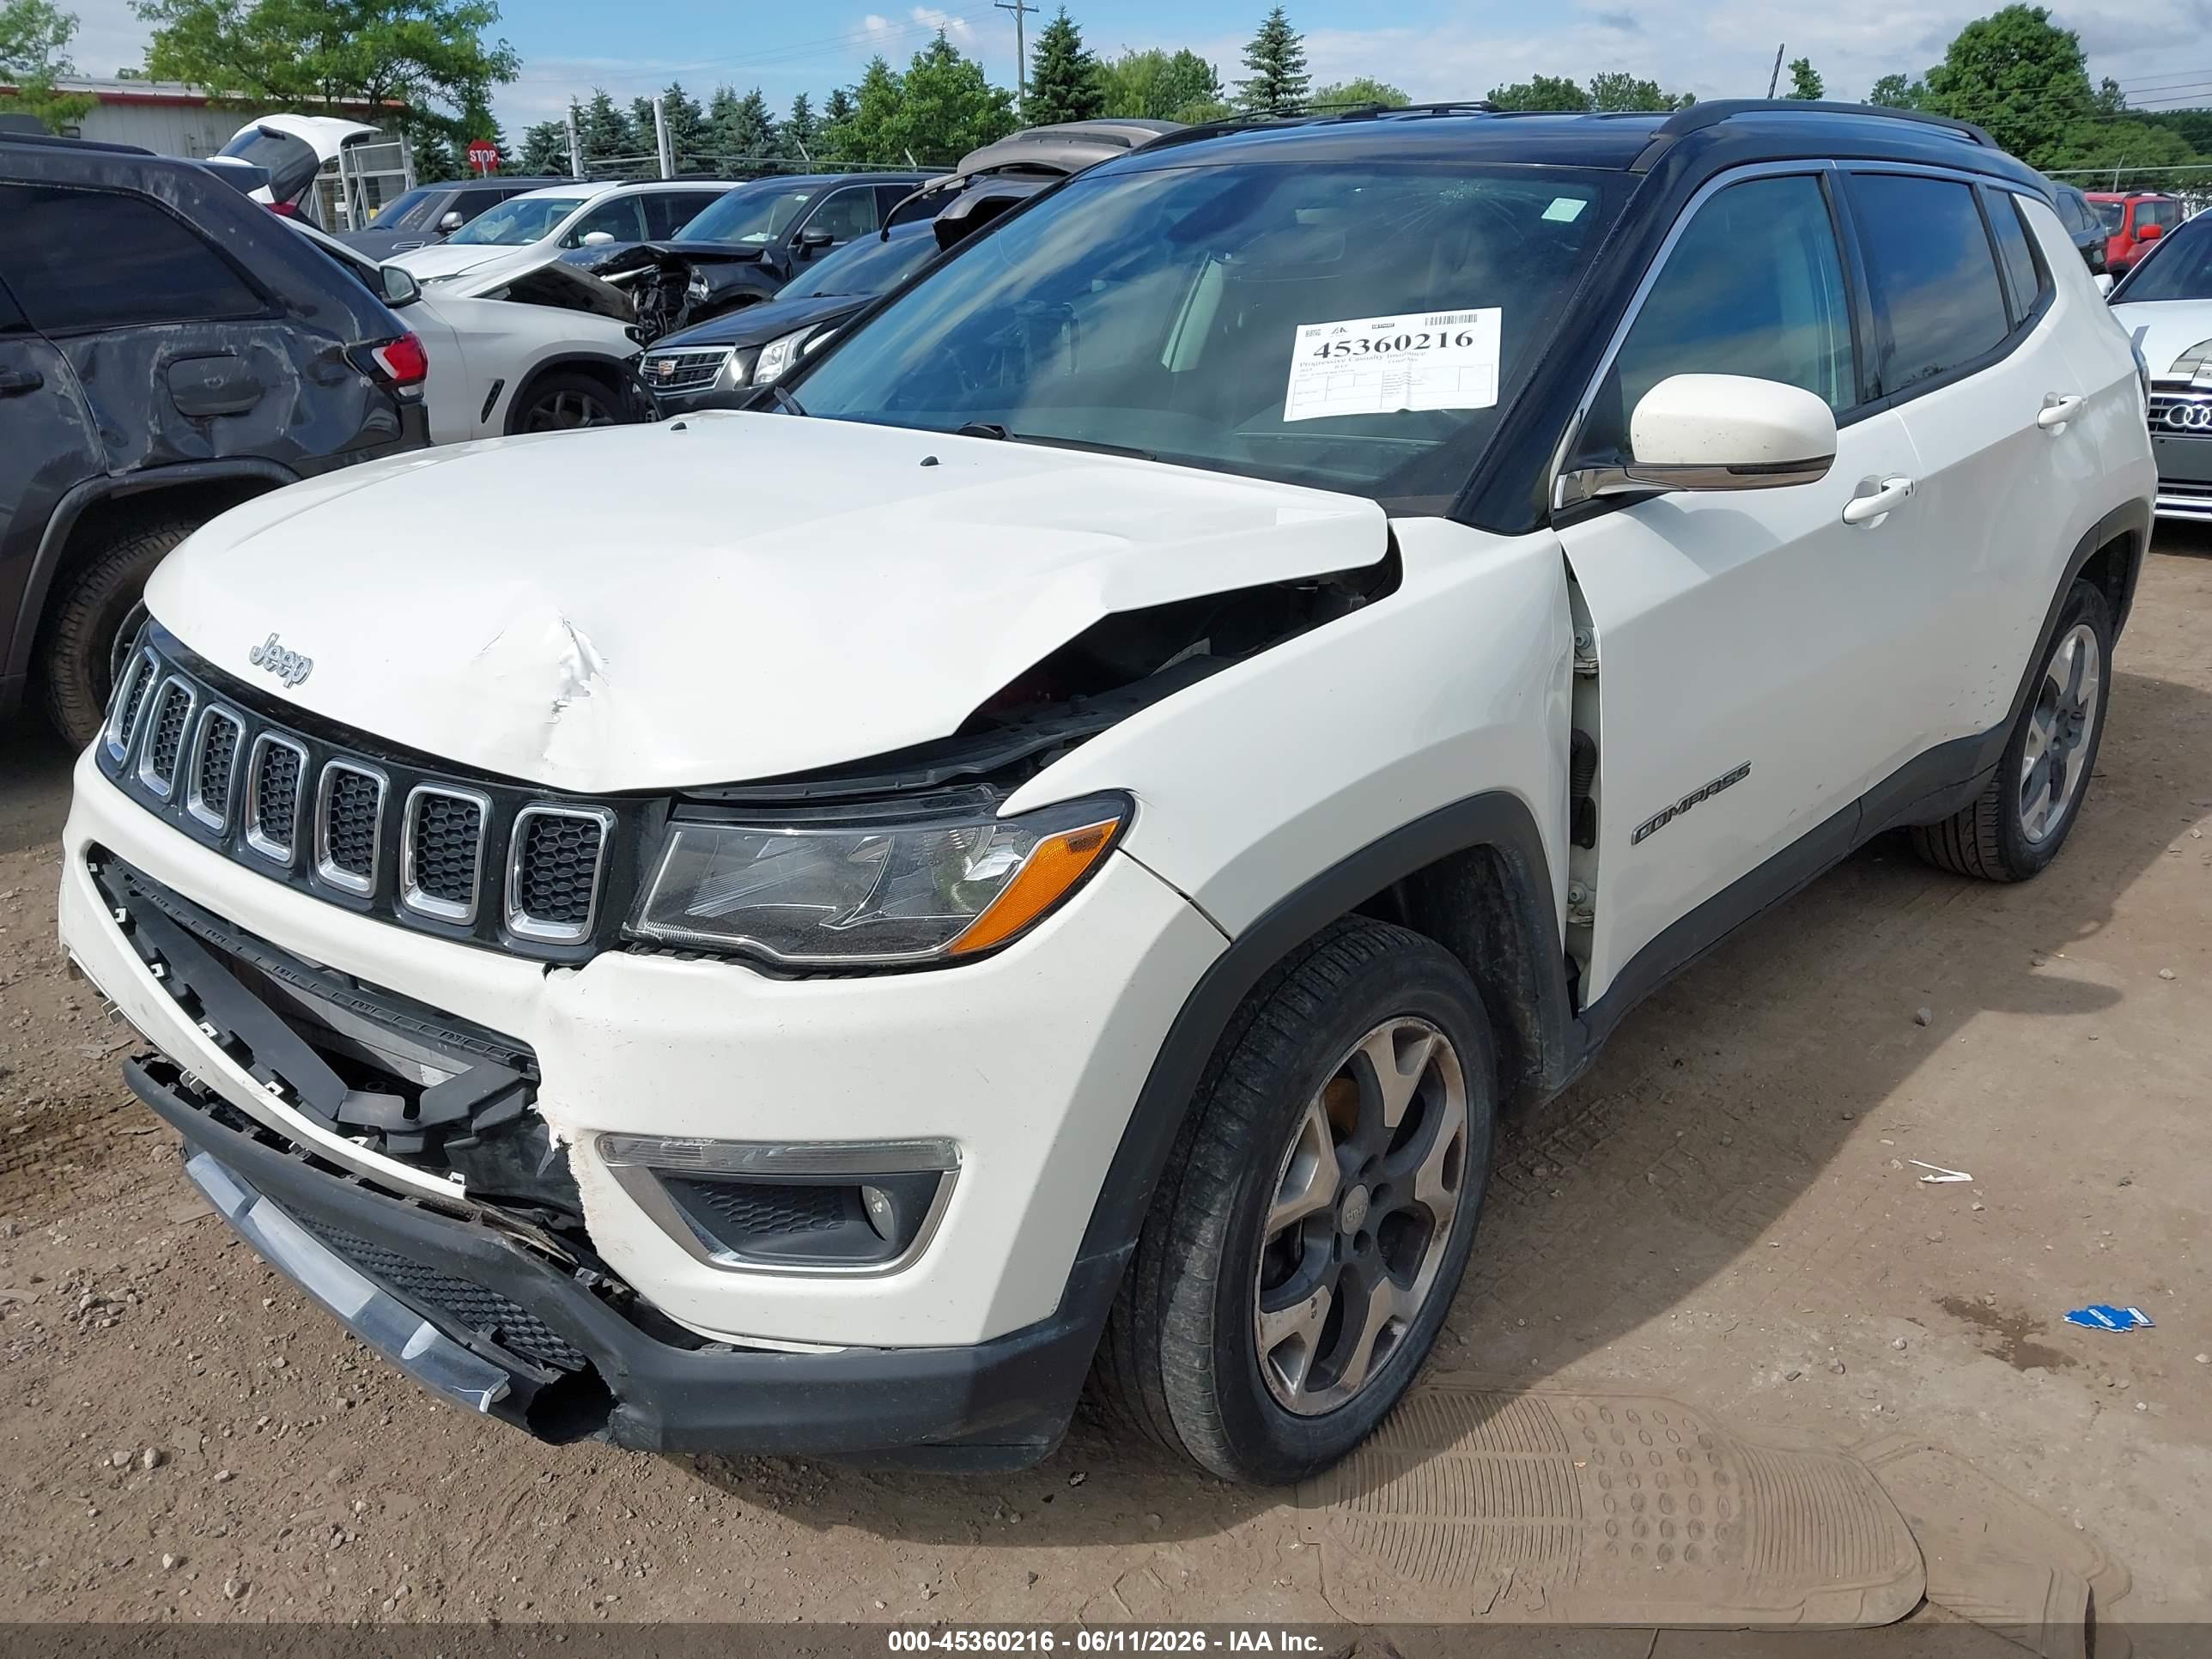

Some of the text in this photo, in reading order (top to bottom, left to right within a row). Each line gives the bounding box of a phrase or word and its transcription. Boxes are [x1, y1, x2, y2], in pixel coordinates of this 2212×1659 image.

[470, 149, 496, 162] STOP
[1313, 329, 1475, 359] 45360216
[249, 632, 314, 690] Jeep
[1632, 760, 1752, 845] COMPASS
